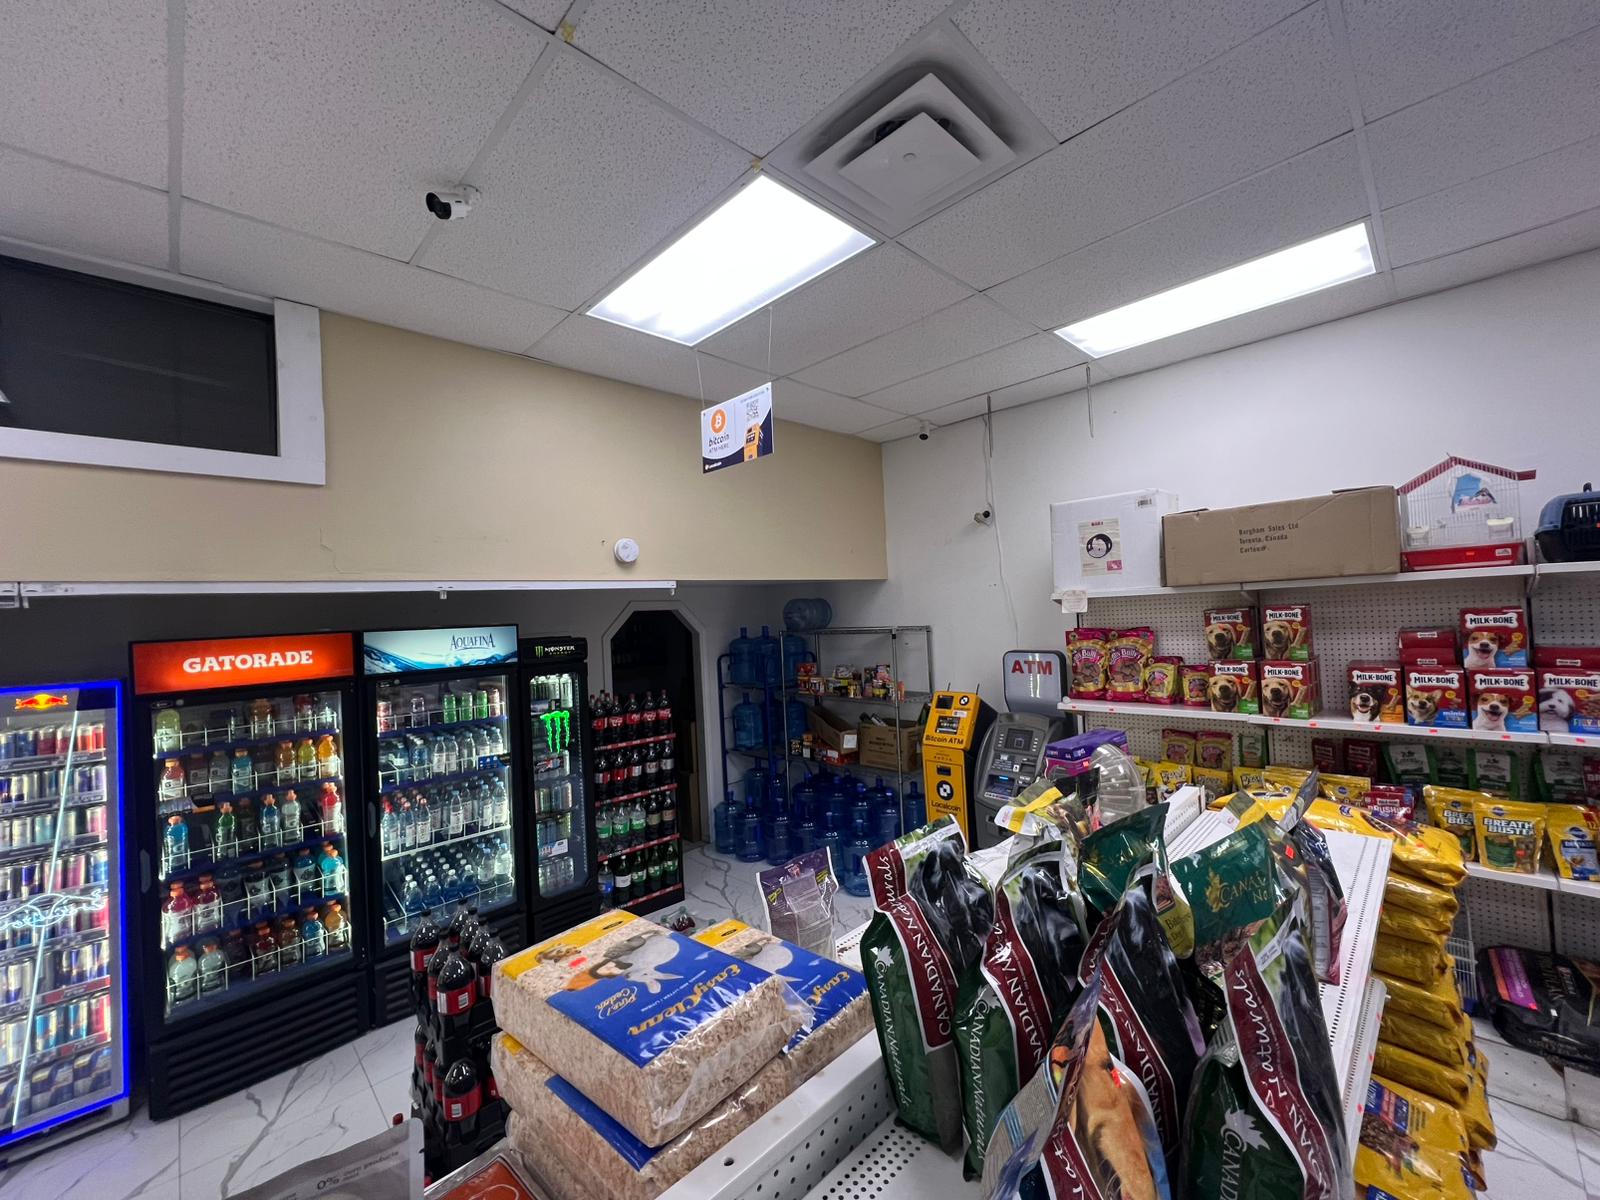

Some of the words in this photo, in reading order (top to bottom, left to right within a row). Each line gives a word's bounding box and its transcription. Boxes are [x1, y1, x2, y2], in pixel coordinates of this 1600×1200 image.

[1268, 524, 1285, 532] Sales
[1265, 534, 1288, 542] Canada
[1269, 611, 1299, 619] MILK-BONE
[1469, 616, 1514, 625] MILK-BONE
[451, 633, 496, 650] AQUAFINA
[183, 650, 313, 674] GATORADE
[1011, 659, 1053, 675] ATM
[1356, 672, 1393, 682] MILK-BONE
[1413, 676, 1456, 685] MILK-BONE
[1479, 678, 1525, 687] MILK-BONE
[1548, 678, 1598, 688] MILK-BONE
[925, 734, 948, 743] Bitcoin
[949, 736, 964, 745] ATM
[931, 801, 961, 812] Localcoin
[1444, 810, 1473, 818] BREA
[1484, 818, 1533, 829] BREATH
[805, 970, 850, 1006] EasyC
[913, 935, 951, 1036] CANADIAN
[595, 988, 630, 1010] Cedar
[627, 963, 741, 1037] EasyClean
[875, 961, 895, 1037] CANADIAN
[1233, 968, 1288, 1098] Naturals
[969, 999, 990, 1083] CANADIAN
[317, 1177, 340, 1190] 0%
